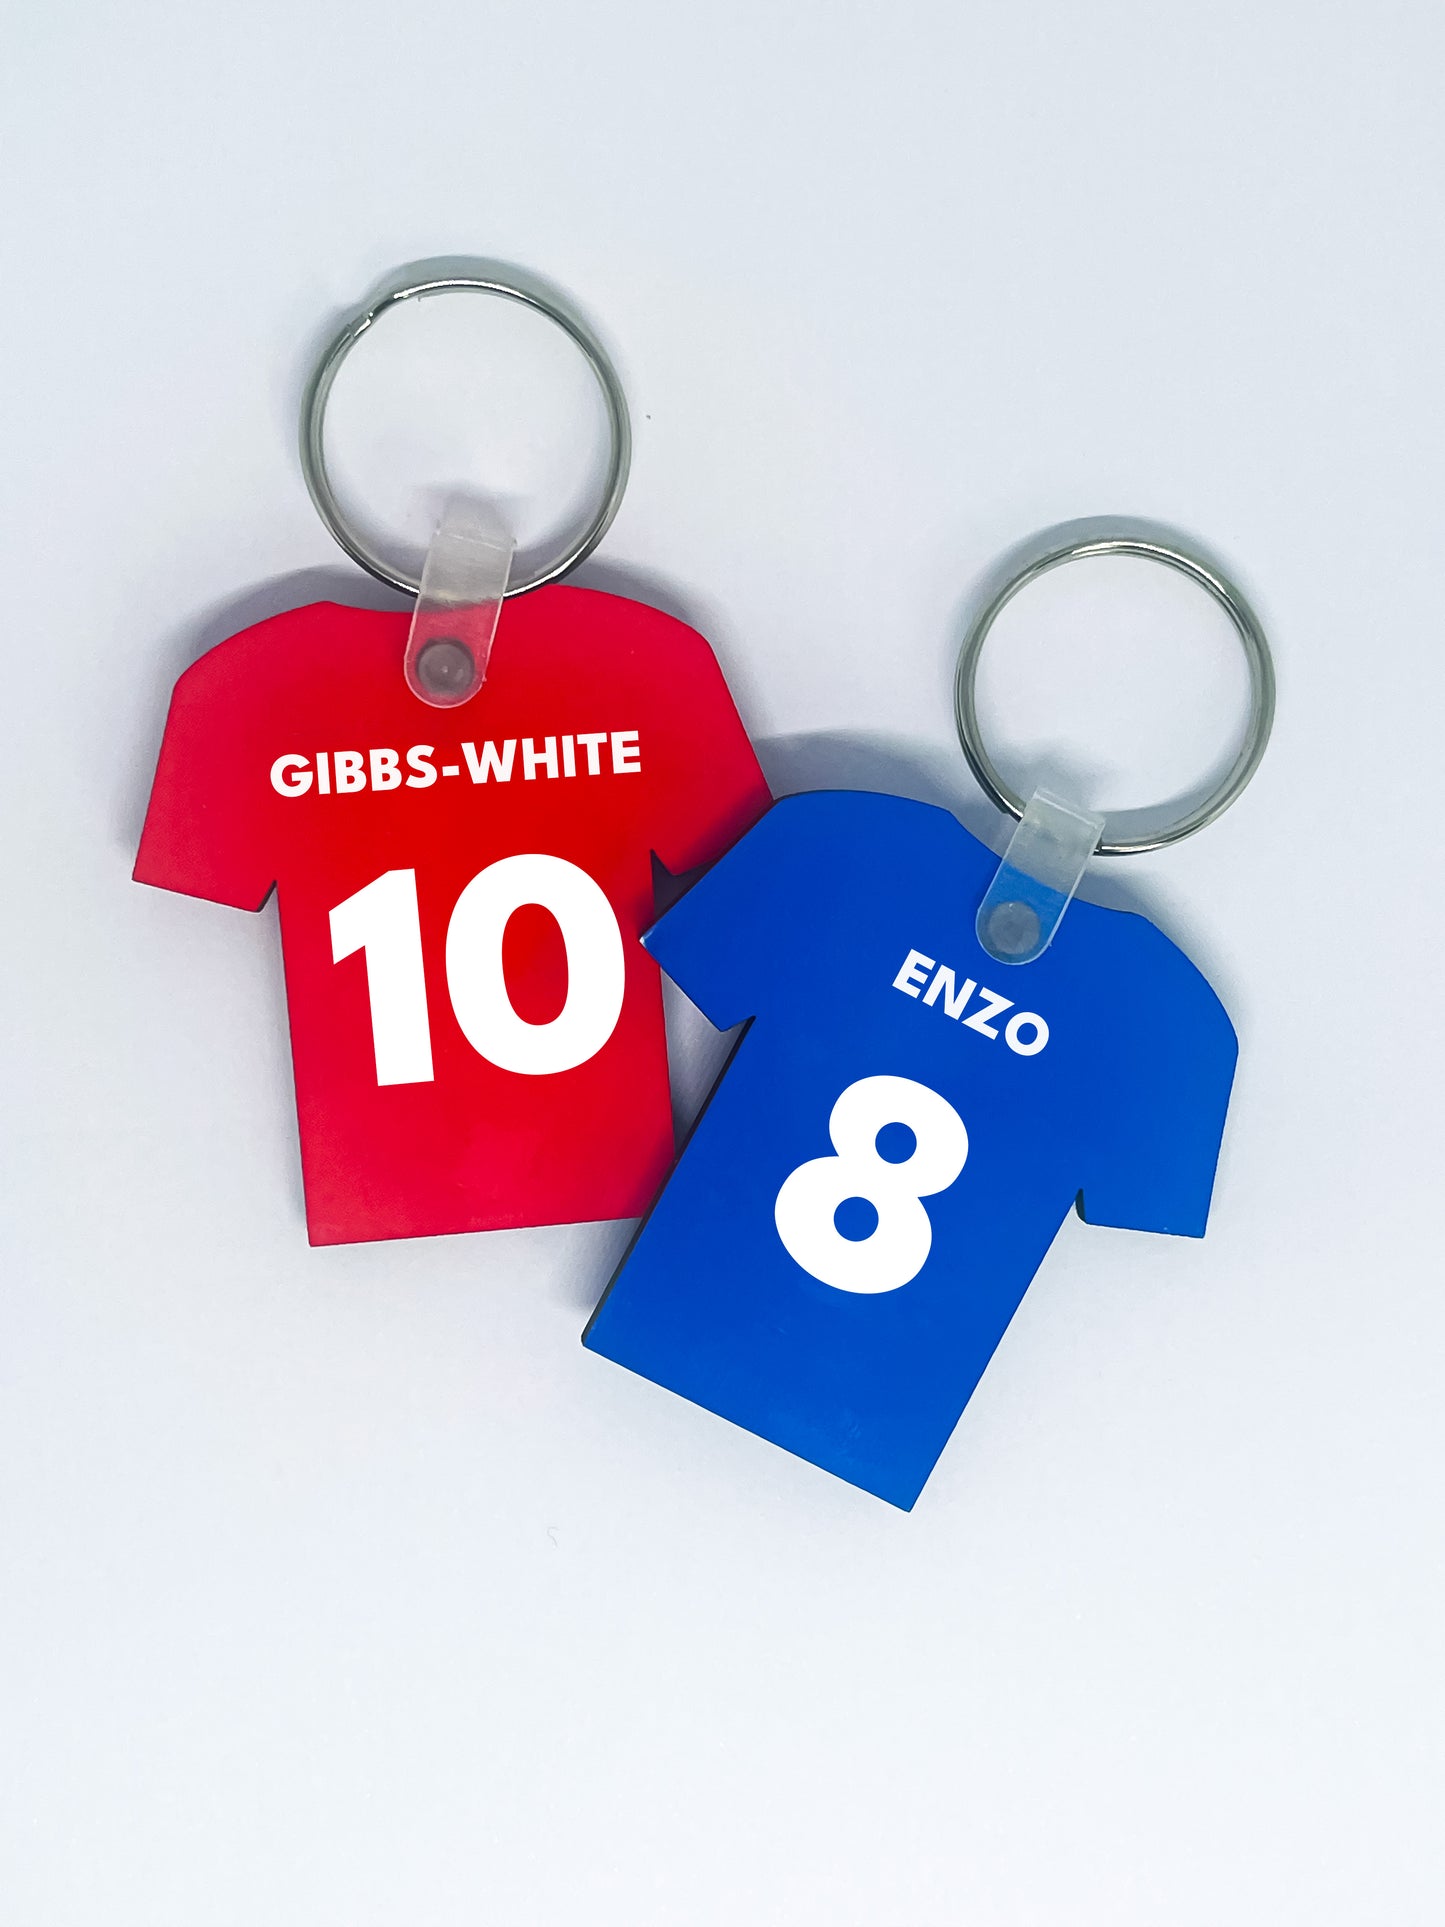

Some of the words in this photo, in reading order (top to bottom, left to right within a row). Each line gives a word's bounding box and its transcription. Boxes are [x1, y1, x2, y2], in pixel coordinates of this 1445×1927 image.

[270, 730, 642, 797] GIBBS-WHITE
[328, 853, 625, 1087] 10
[892, 949, 1050, 1056] ENZO
[774, 1075, 969, 1294] 8
